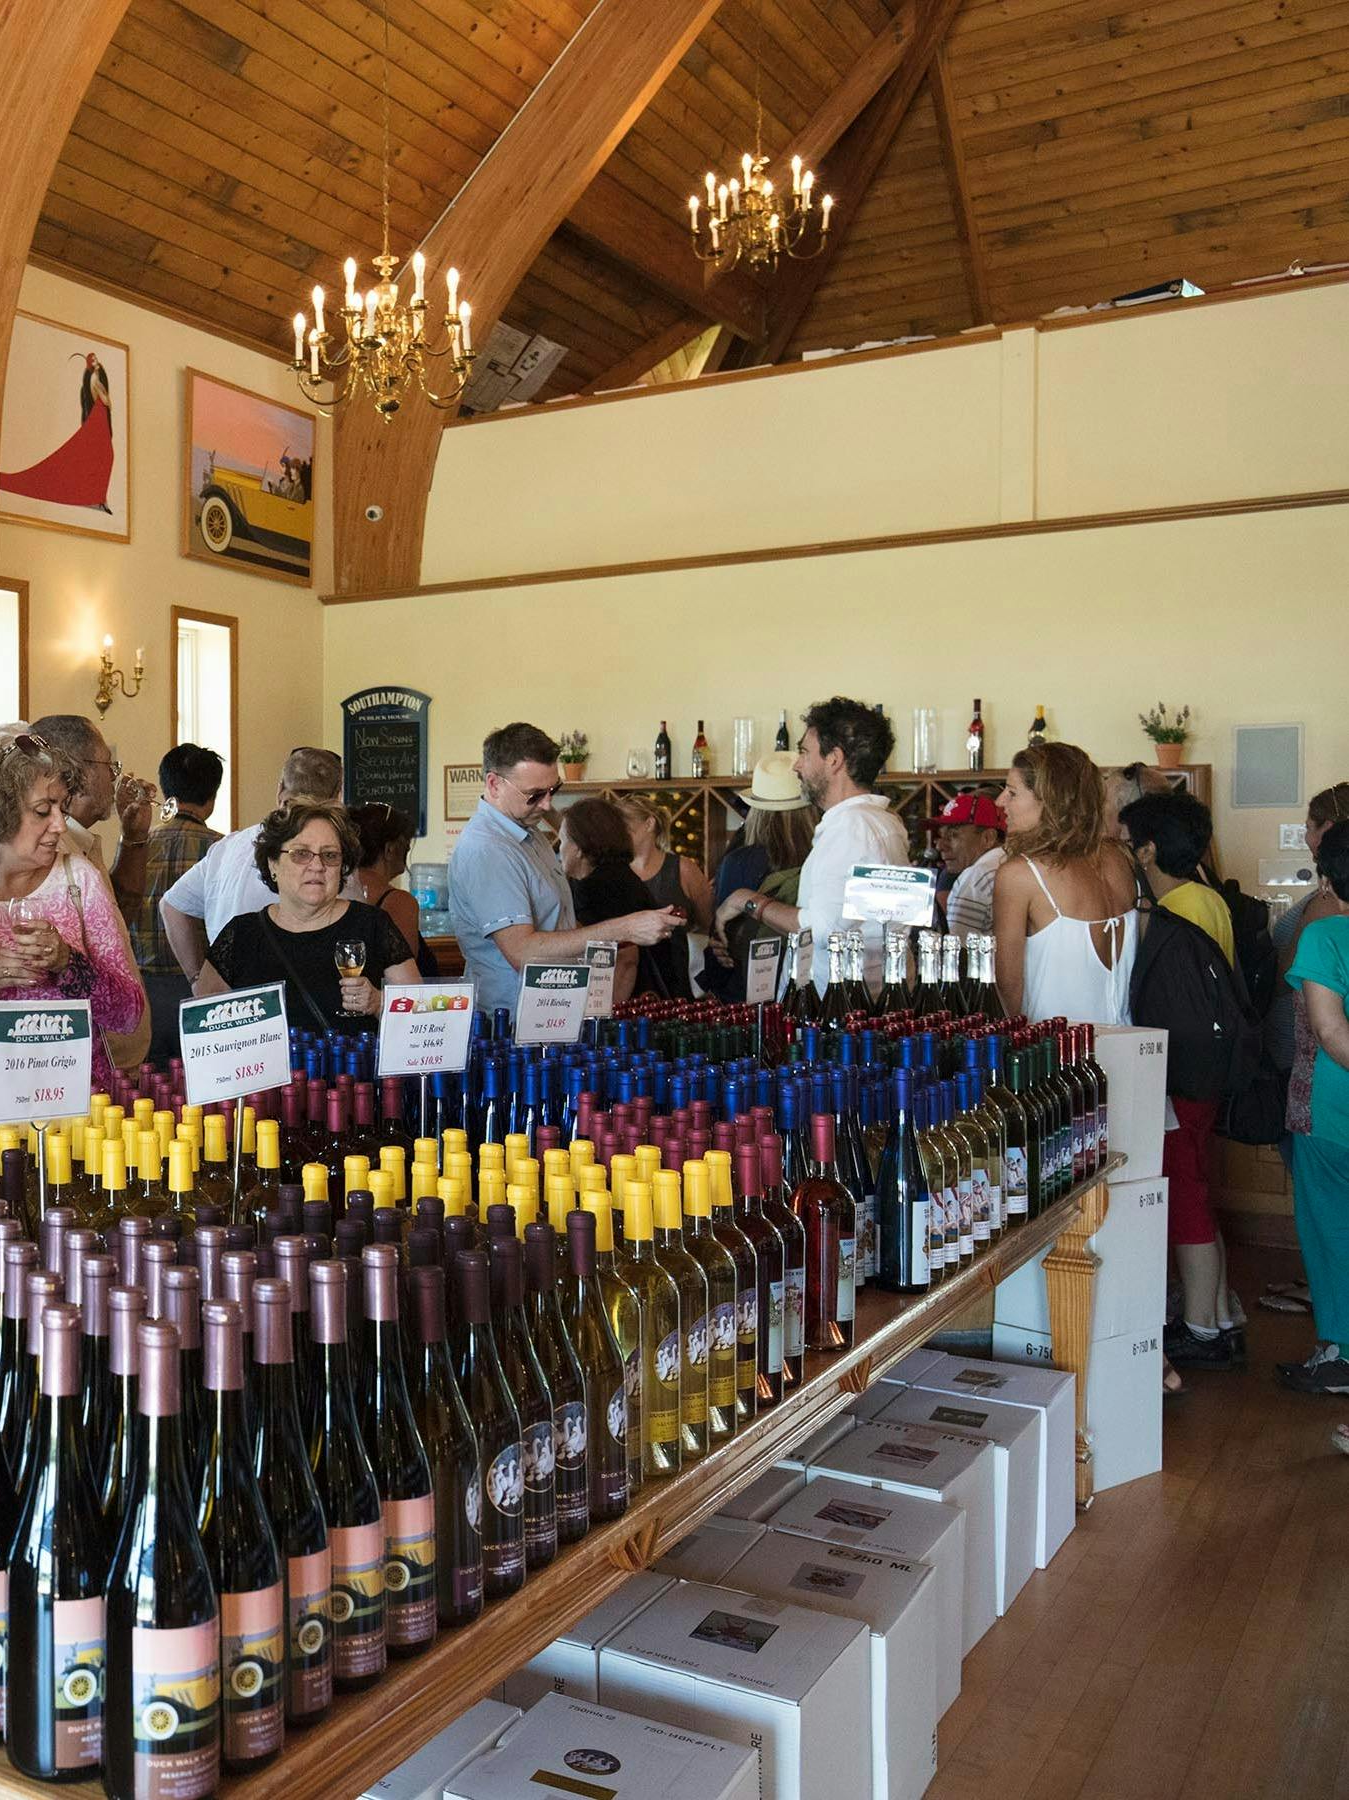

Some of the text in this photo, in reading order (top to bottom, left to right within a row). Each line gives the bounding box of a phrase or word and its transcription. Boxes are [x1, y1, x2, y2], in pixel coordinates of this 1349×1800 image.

[347, 692, 424, 715] SOUTHAMPTON
[449, 769, 483, 783] WARN
[396, 1000, 462, 1011] SALE
[208, 1017, 259, 1031] DUCK WALK
[410, 1023, 446, 1034] 2015 Rosé
[15, 1035, 39, 1043] DUCK
[190, 1032, 282, 1059] 2015 Sauvignon Blanc
[5, 1055, 76, 1070] 2016 Pinot Grigio
[235, 1062, 265, 1080] $18.95
[34, 1087, 64, 1102] $18.95
[828, 1548, 882, 1565] 12-750
[890, 1561, 916, 1573] ML
[67, 1725, 92, 1734] DUCK
[147, 1757, 199, 1768] DUCK WALK
